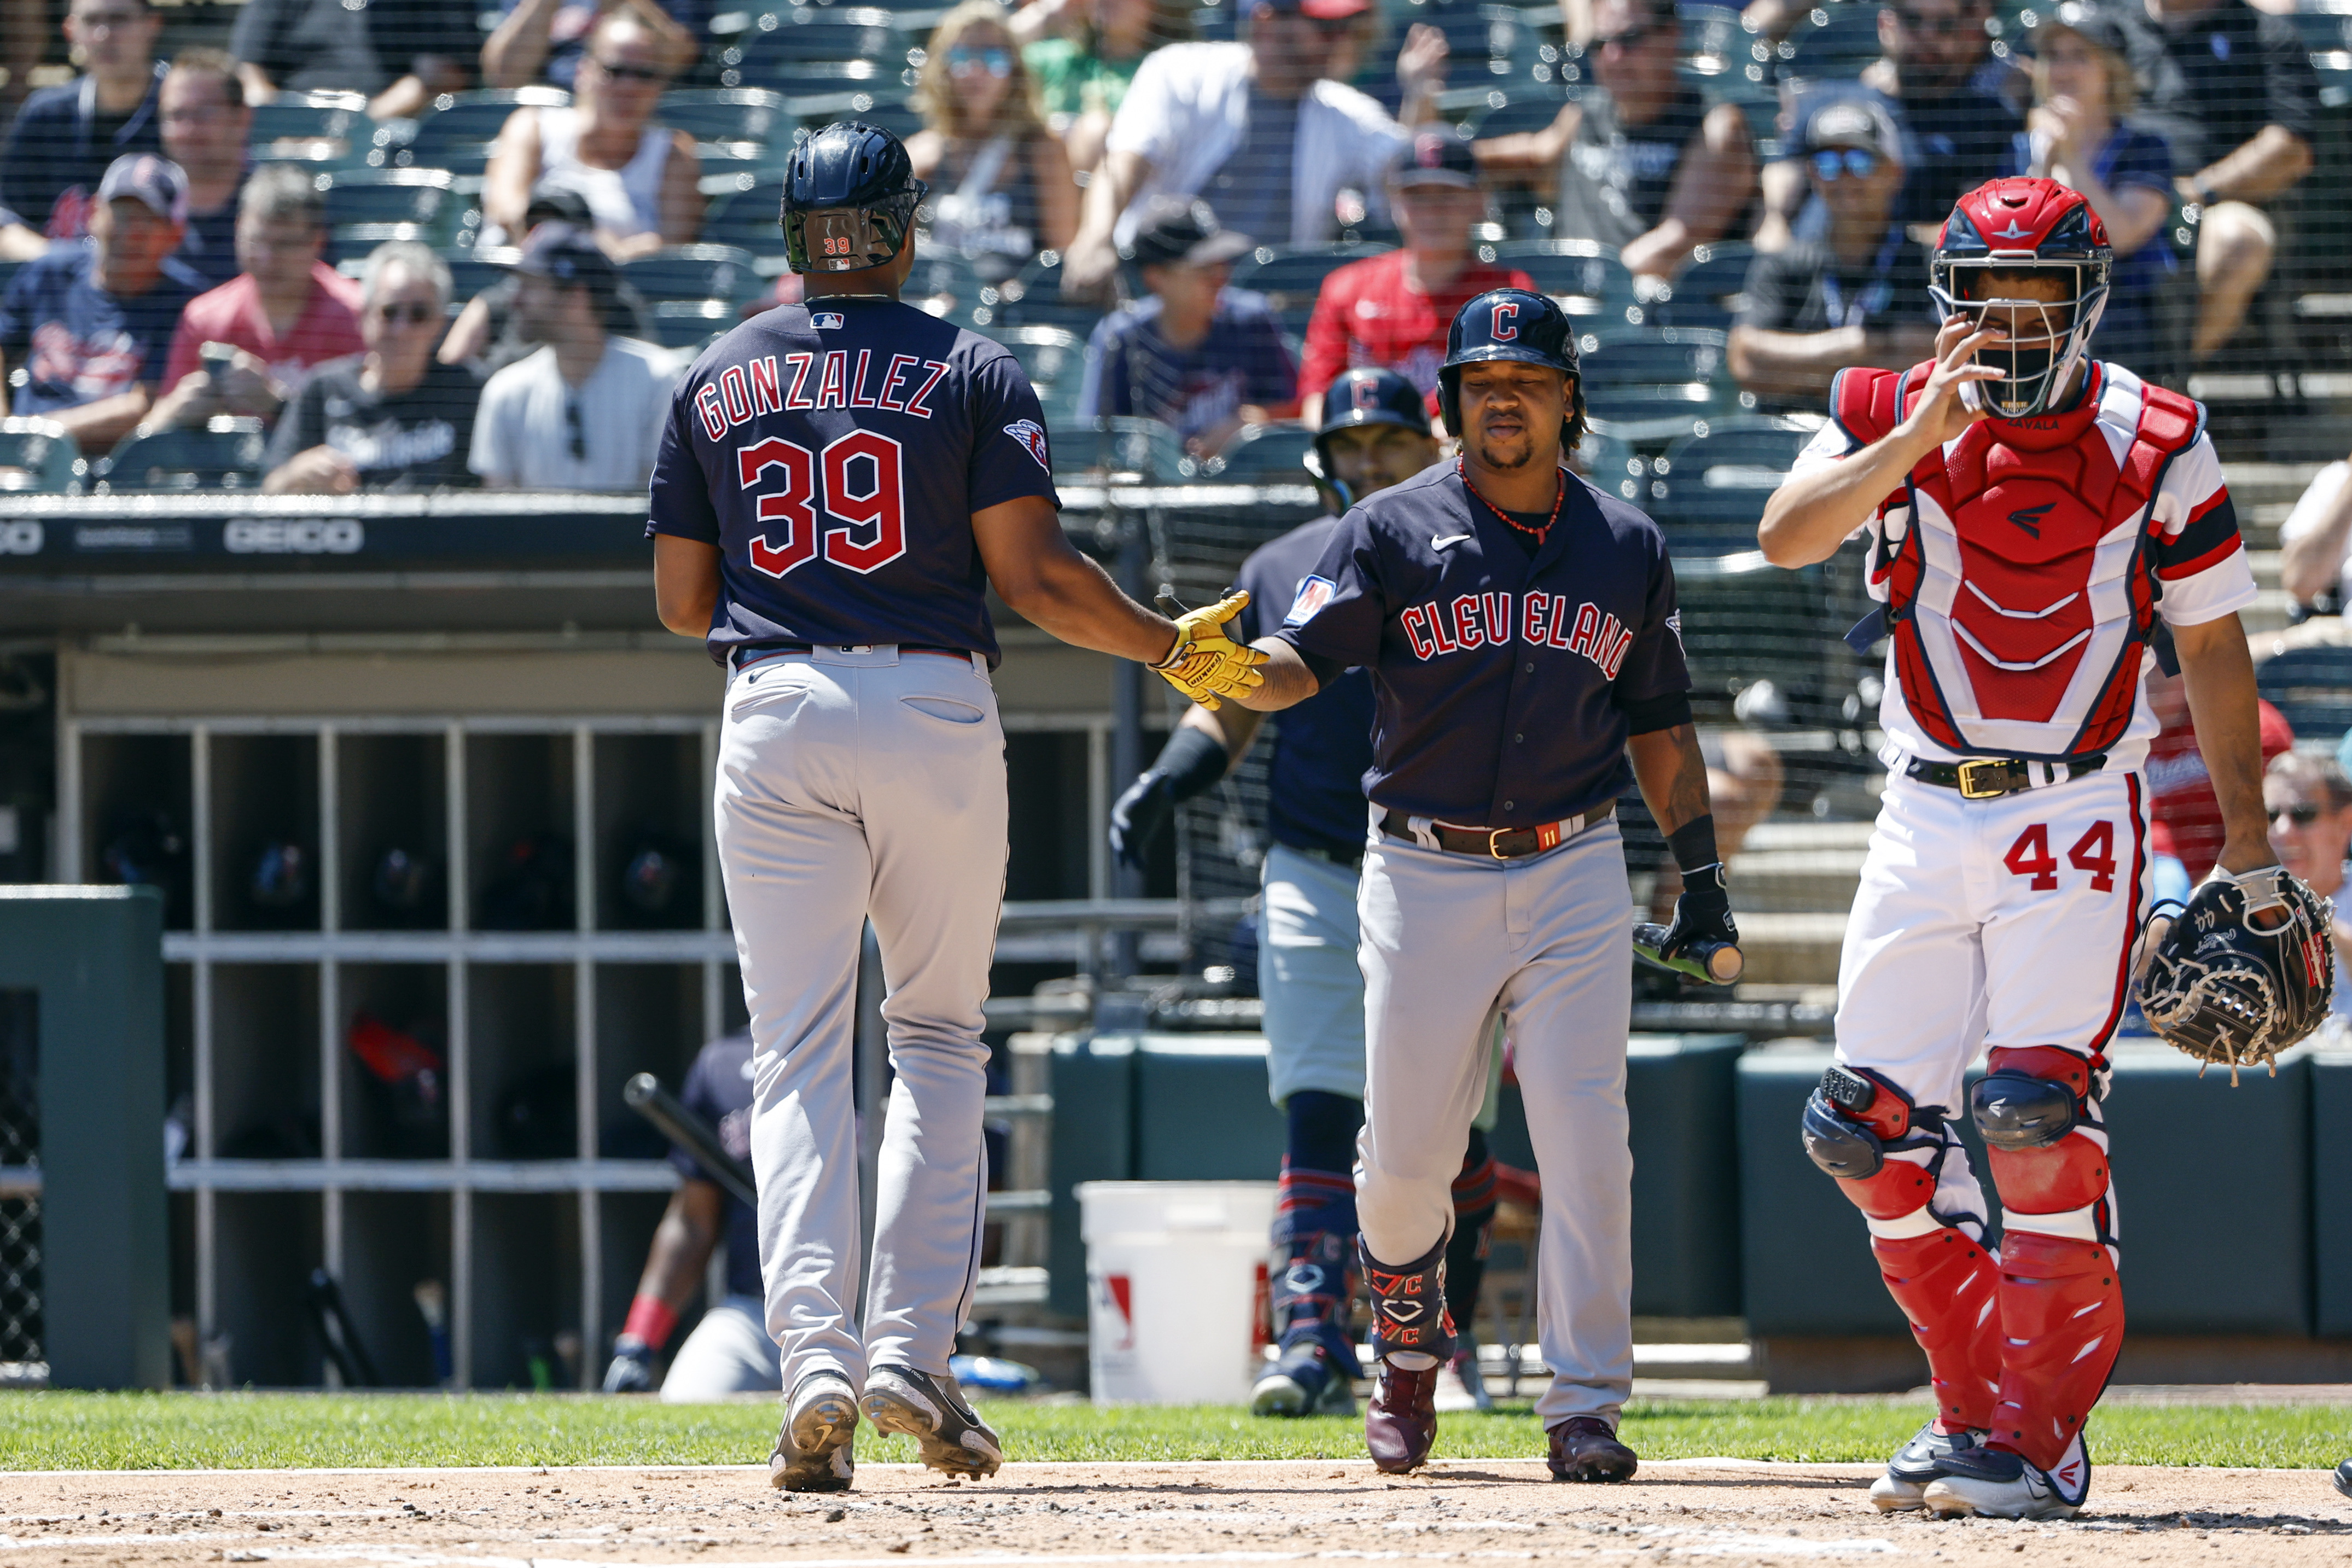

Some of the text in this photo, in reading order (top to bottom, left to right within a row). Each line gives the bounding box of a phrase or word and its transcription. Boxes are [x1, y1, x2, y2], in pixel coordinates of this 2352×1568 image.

[824, 237, 849, 255] 39
[1491, 302, 1520, 342] C
[695, 349, 951, 442] GONZALEZ
[2007, 417, 2059, 430] ZAVALA
[737, 428, 906, 579] 39
[223, 518, 364, 554] GEICO
[1400, 590, 1633, 681] CLEVELAND
[1544, 829, 1556, 847] 11
[2002, 820, 2117, 893] 44
